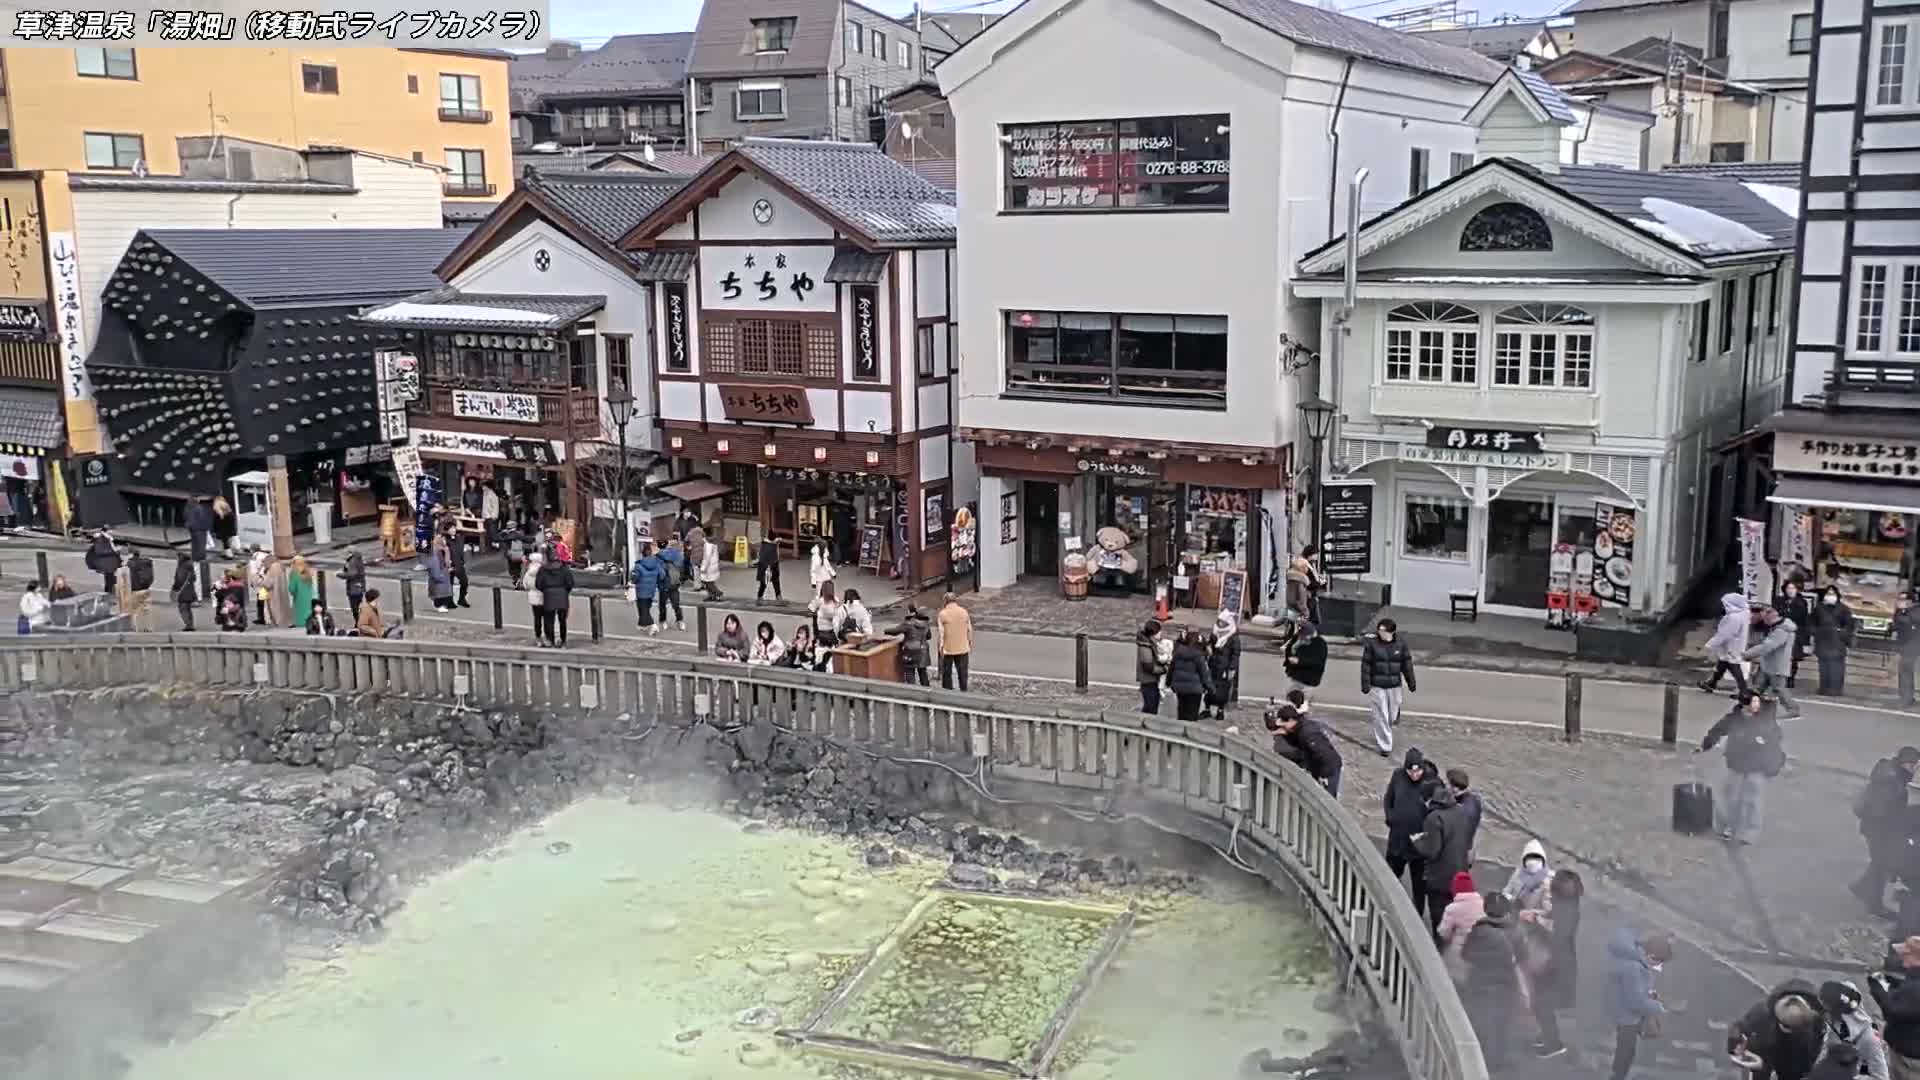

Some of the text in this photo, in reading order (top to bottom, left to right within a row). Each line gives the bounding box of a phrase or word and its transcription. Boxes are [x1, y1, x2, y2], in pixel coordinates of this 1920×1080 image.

[719, 271, 814, 301] ちちや
[748, 391, 799, 415] ちちや
[1800, 440, 1918, 461] 手作りお菓子工房
